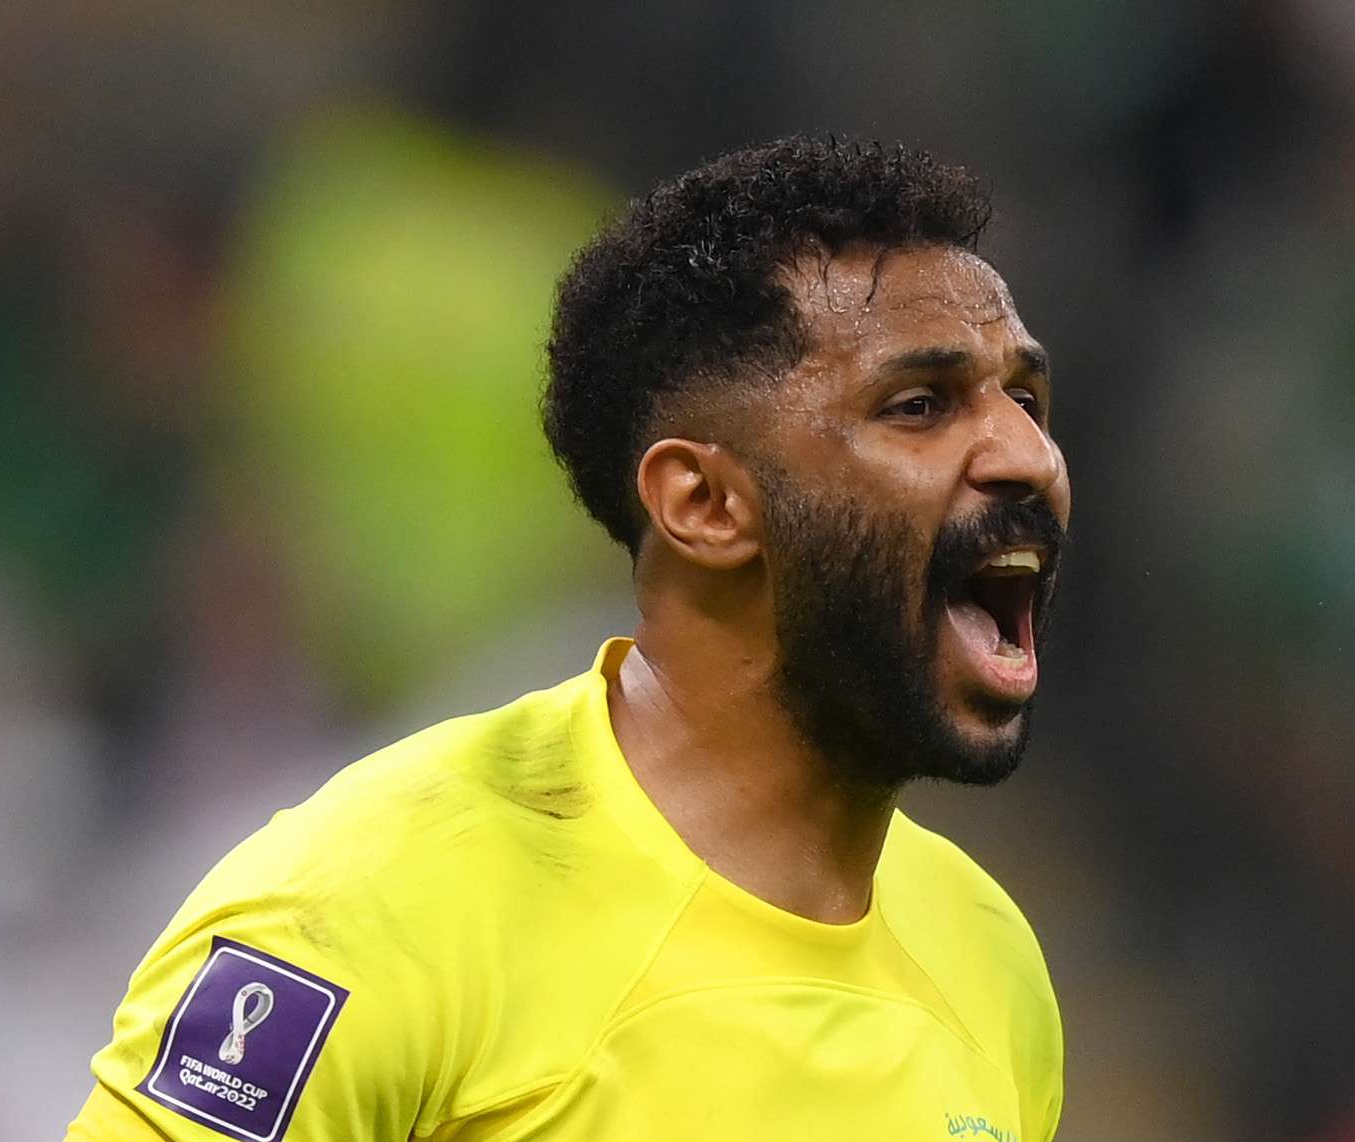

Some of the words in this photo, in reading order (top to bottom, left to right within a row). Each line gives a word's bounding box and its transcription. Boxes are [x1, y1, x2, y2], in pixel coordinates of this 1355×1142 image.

[179, 1055, 203, 1073] FIFA
[202, 1064, 243, 1089] WORLD
[242, 1083, 268, 1100] CUP
